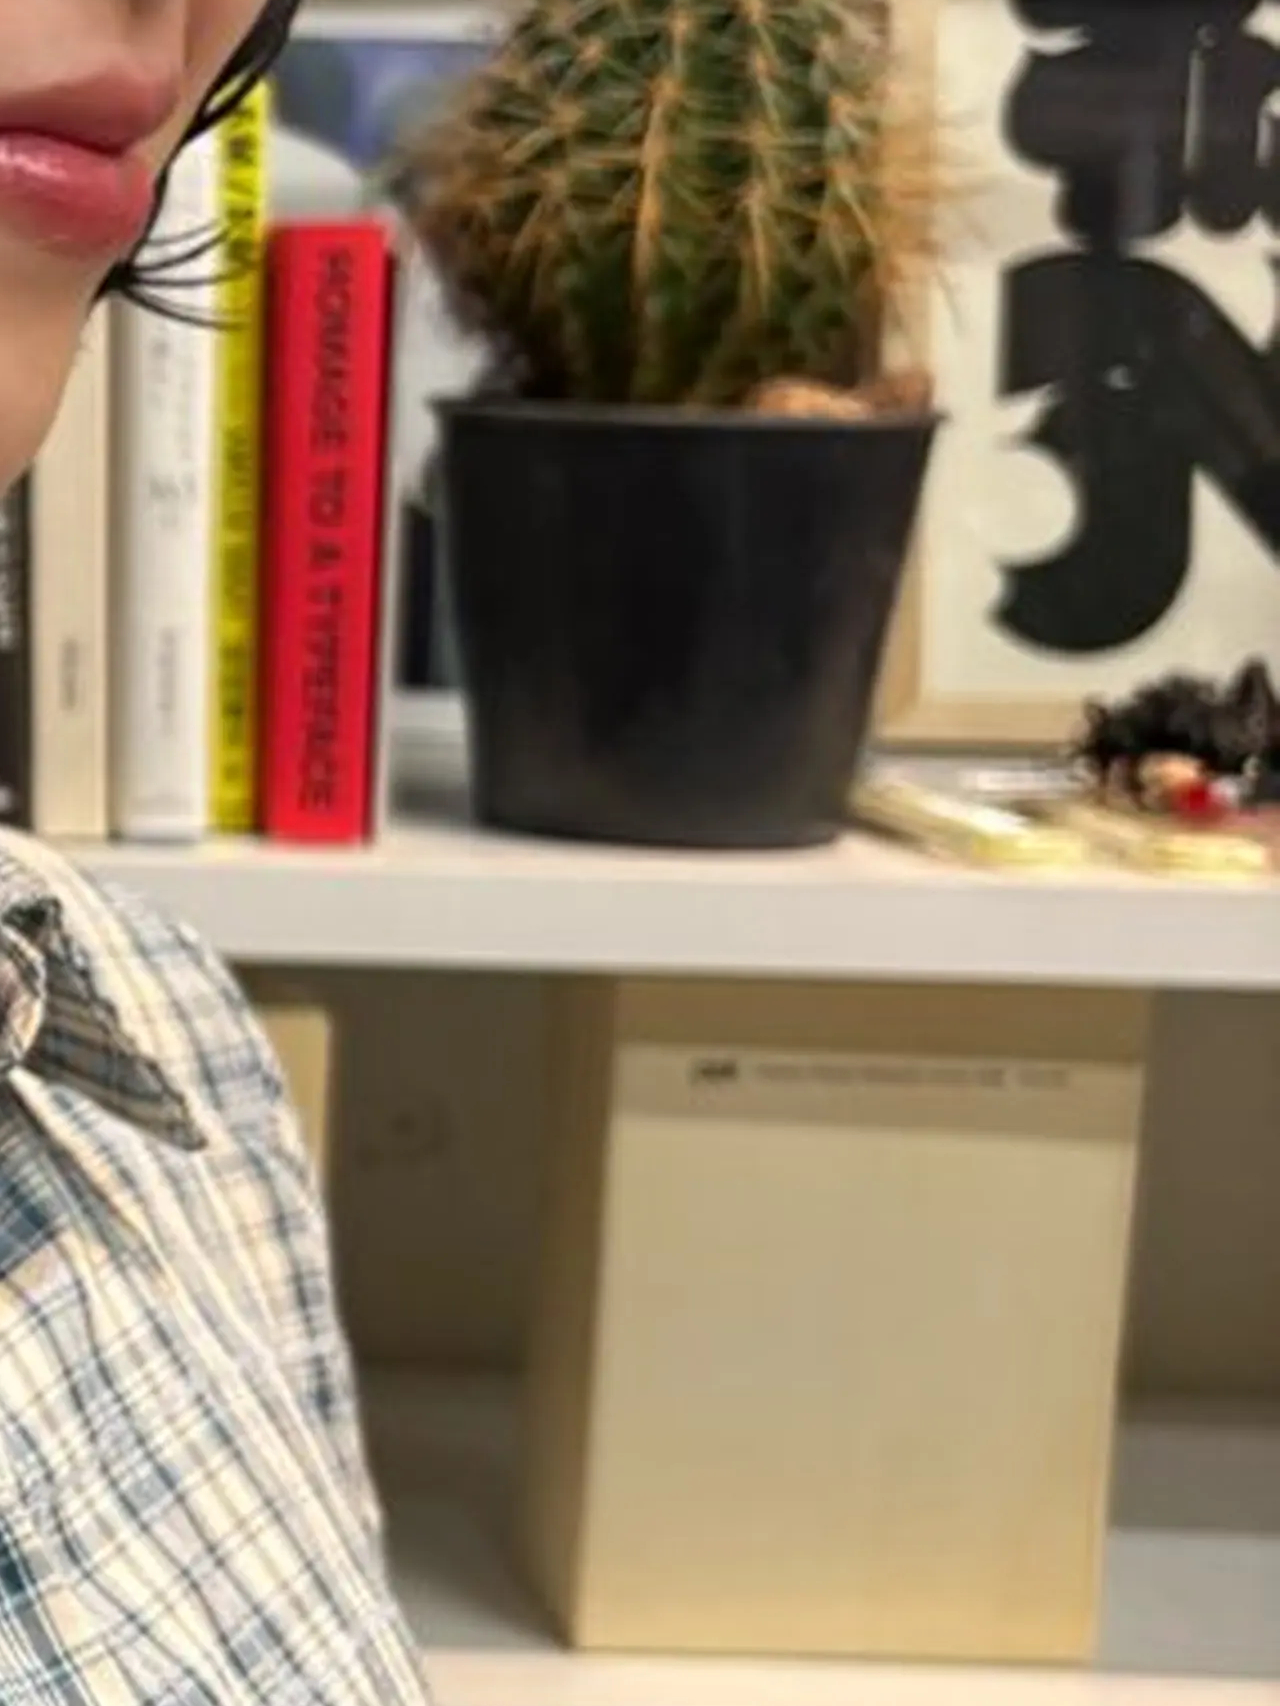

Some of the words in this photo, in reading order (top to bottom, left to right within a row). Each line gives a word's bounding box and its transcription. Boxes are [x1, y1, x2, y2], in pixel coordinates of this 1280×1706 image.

[310, 250, 354, 451] HOMAGE
[307, 469, 347, 528] TO
[307, 543, 342, 567] A
[299, 584, 341, 811] TYPEFACE
